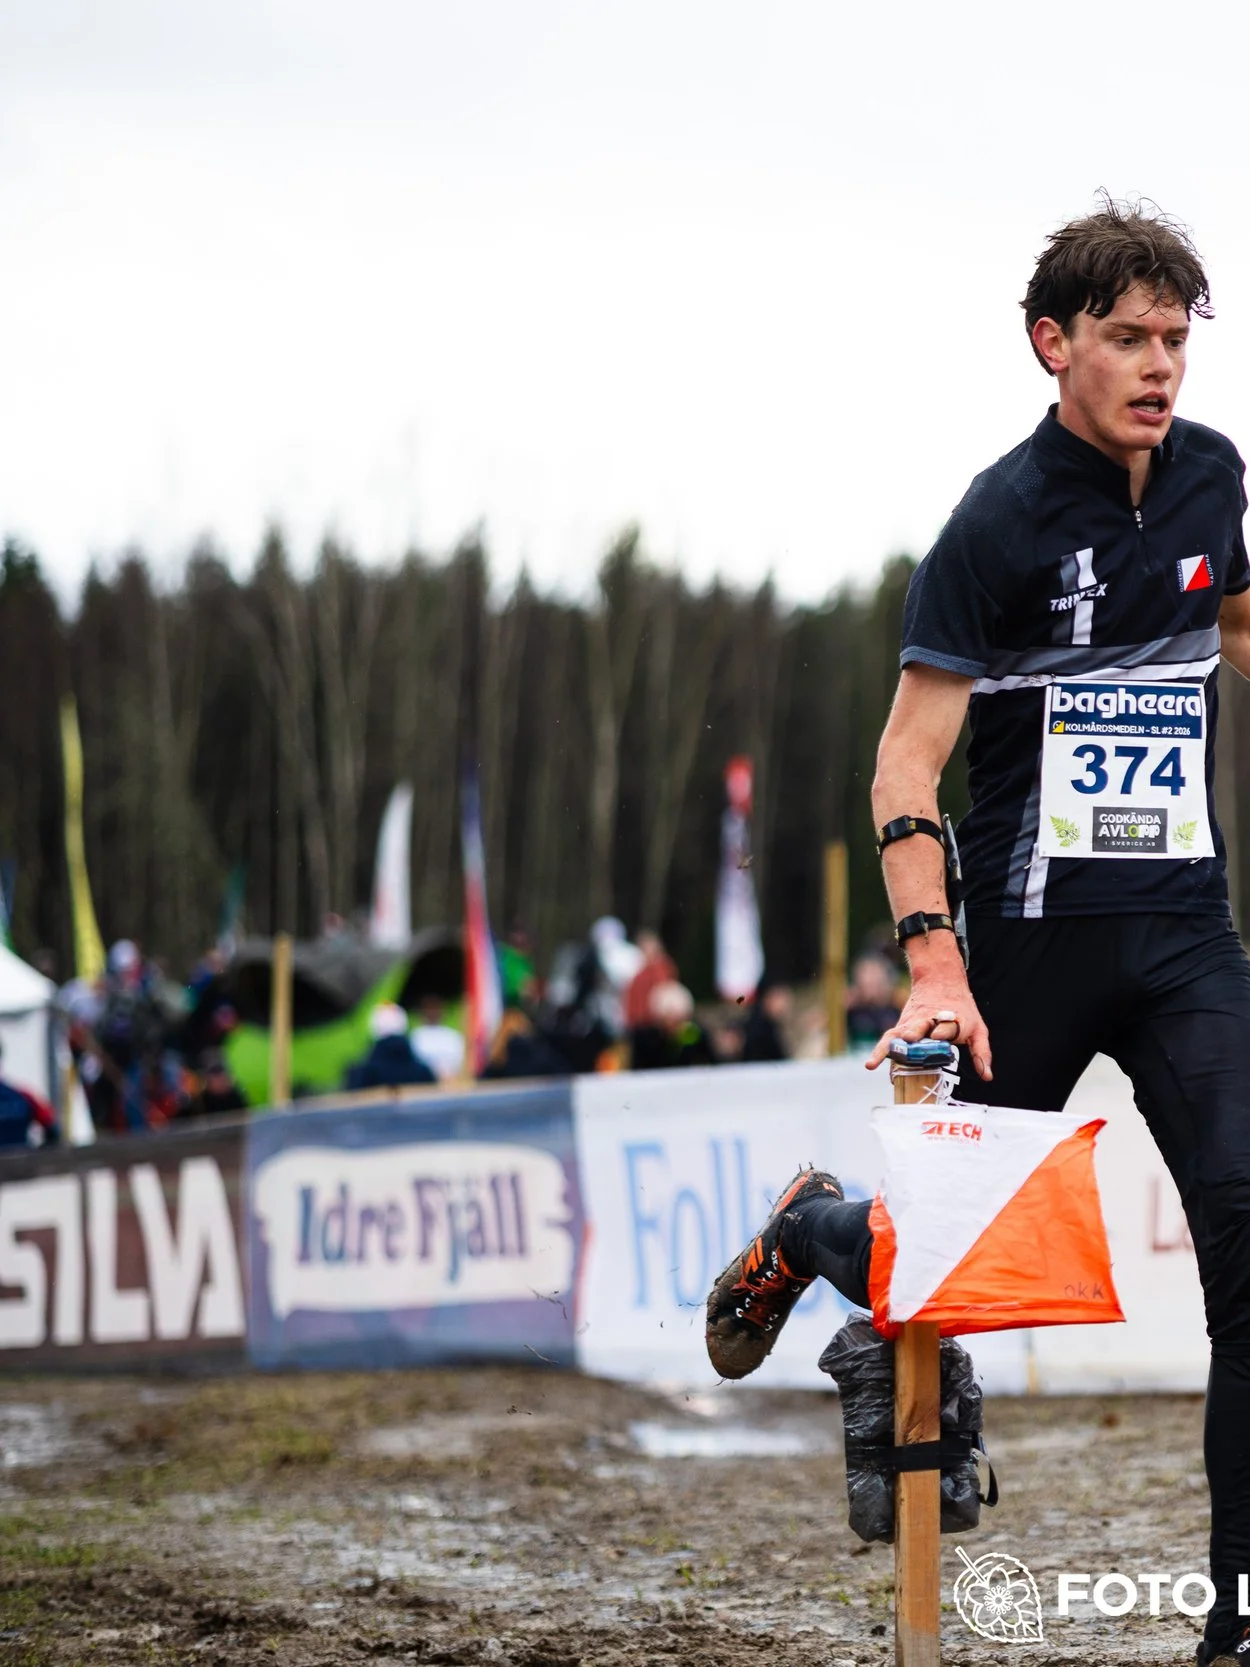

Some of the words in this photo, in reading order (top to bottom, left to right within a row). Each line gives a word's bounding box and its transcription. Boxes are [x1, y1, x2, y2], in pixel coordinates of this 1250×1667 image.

[1051, 686, 1202, 719] bagheera
[1065, 721, 1145, 734] KOLMÅRDSMEDELN
[1151, 726, 1161, 735] SL
[1161, 726, 1172, 735] #2
[1174, 727, 1191, 736] 2026
[1070, 744, 1186, 796] 374
[1098, 825, 1160, 838] AVLOPP
[1099, 812, 1161, 825] GODKÄNDA
[298, 1182, 405, 1262] Idre
[412, 1169, 530, 1284] Fjäll
[0, 1156, 247, 1349] SILVA
